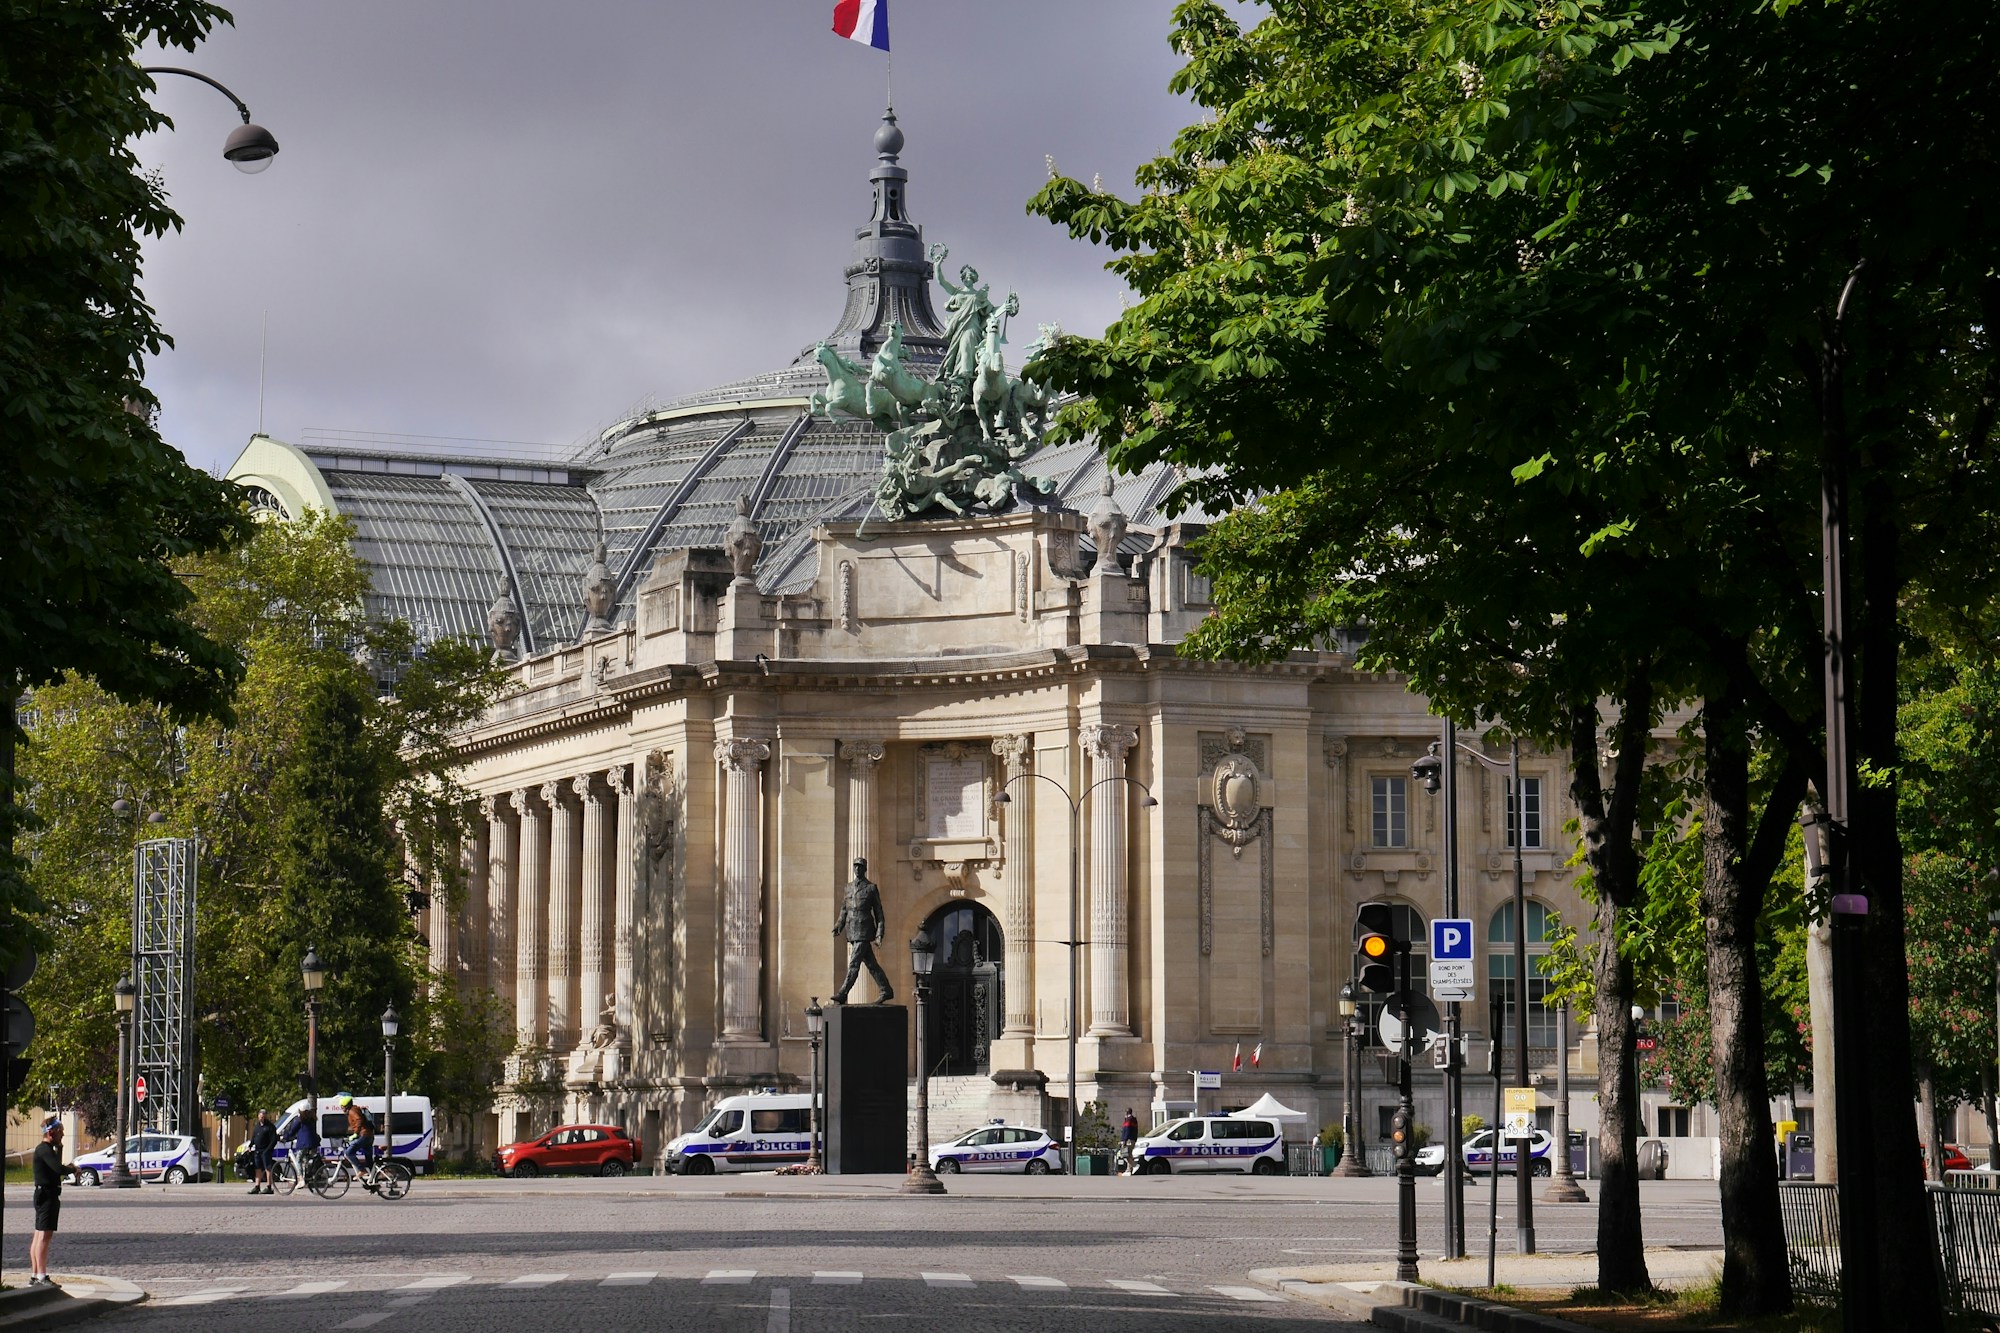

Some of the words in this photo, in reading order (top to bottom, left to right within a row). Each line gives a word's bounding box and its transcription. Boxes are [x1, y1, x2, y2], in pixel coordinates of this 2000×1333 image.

[1443, 927, 1462, 953] P
[753, 1142, 798, 1151] POLICE
[1191, 1147, 1239, 1155] POLICE
[978, 1152, 1018, 1160] POLICE
[127, 1160, 163, 1169] OLICE
